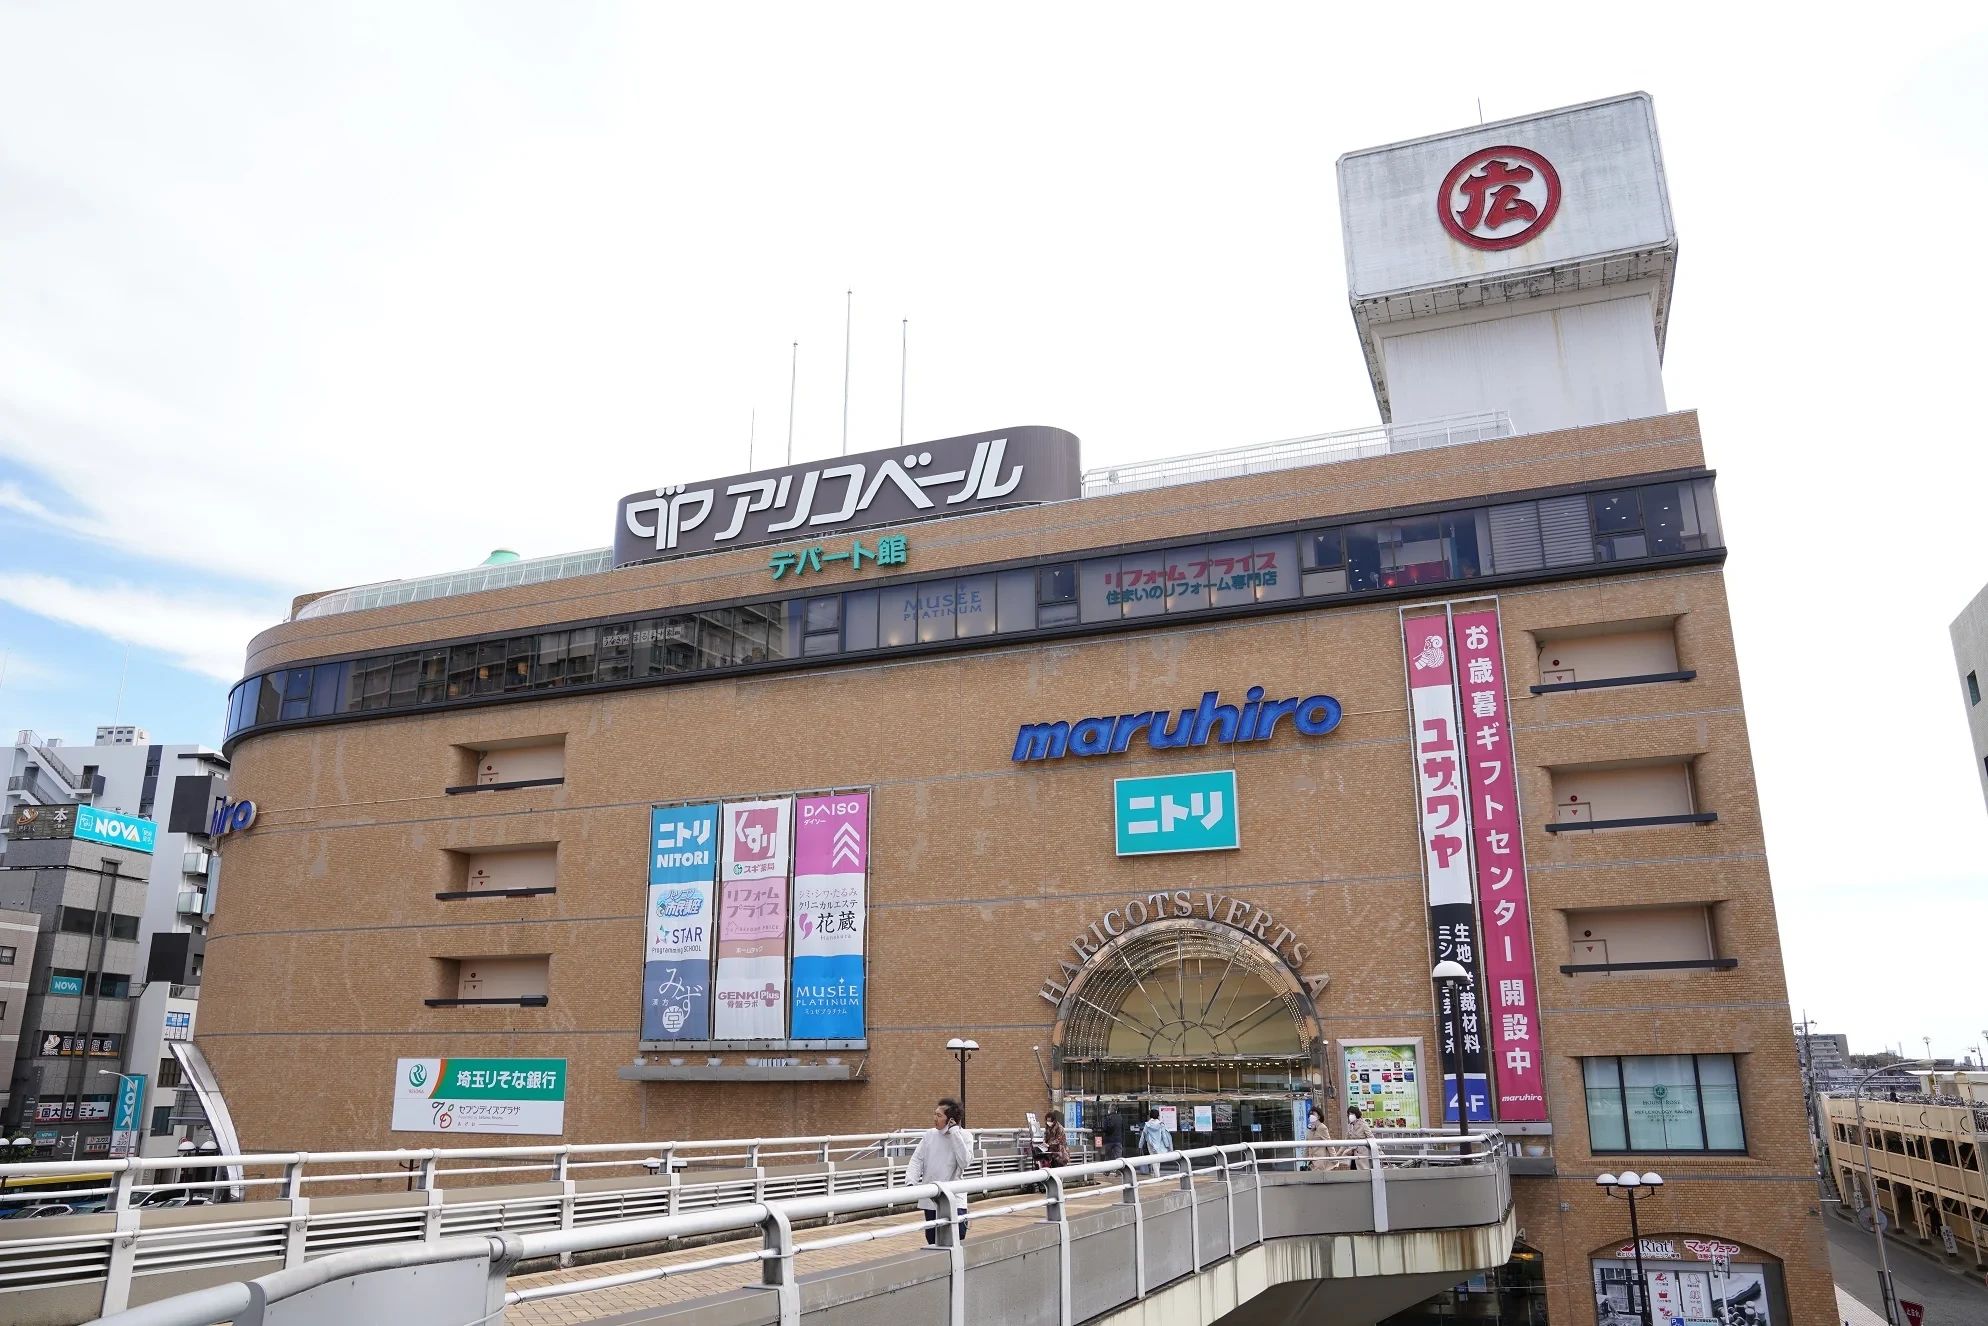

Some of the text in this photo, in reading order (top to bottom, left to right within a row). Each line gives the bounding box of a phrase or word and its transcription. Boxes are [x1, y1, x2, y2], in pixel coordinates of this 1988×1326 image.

[1456, 160, 1538, 230] 広
[713, 438, 1024, 541] アリコベール
[768, 533, 910, 581] デパート館
[1105, 569, 1278, 606] 住まいのリフォーム専門店
[903, 605, 982, 622] PLATINUM
[1011, 685, 1343, 762] maruhiro
[1420, 718, 1463, 870] ユザワヤ
[53, 807, 69, 823] 本
[804, 801, 859, 817] DAISO
[1128, 791, 1223, 834] ニトリ
[95, 817, 141, 843] NOVA
[803, 818, 827, 826] ダイソー
[657, 819, 711, 849] ニトリ
[735, 811, 777, 857] くすり
[1465, 624, 1531, 1075] お歳暮ギフトセンター開設中
[656, 850, 709, 868] NITORI
[743, 862, 775, 874] スギ薬局
[727, 886, 780, 902] リフォーム
[726, 902, 780, 918] プライス
[798, 899, 858, 910] クリニカルエステ
[815, 910, 857, 934] 花蔵
[672, 926, 703, 944] STAR
[54, 980, 78, 991] NOVA
[717, 991, 780, 1000] GENKI Plus
[727, 1000, 759, 1009] 骨盤ラボ
[796, 998, 859, 1006] PLATINUM
[456, 1071, 557, 1089] 埼玉りそな銀行
[121, 1080, 139, 1127] NOVA
[1501, 1093, 1543, 1102] maruhiro
[41, 1106, 105, 1118] 国大セミナー
[1639, 1239, 1674, 1253] Riat!
